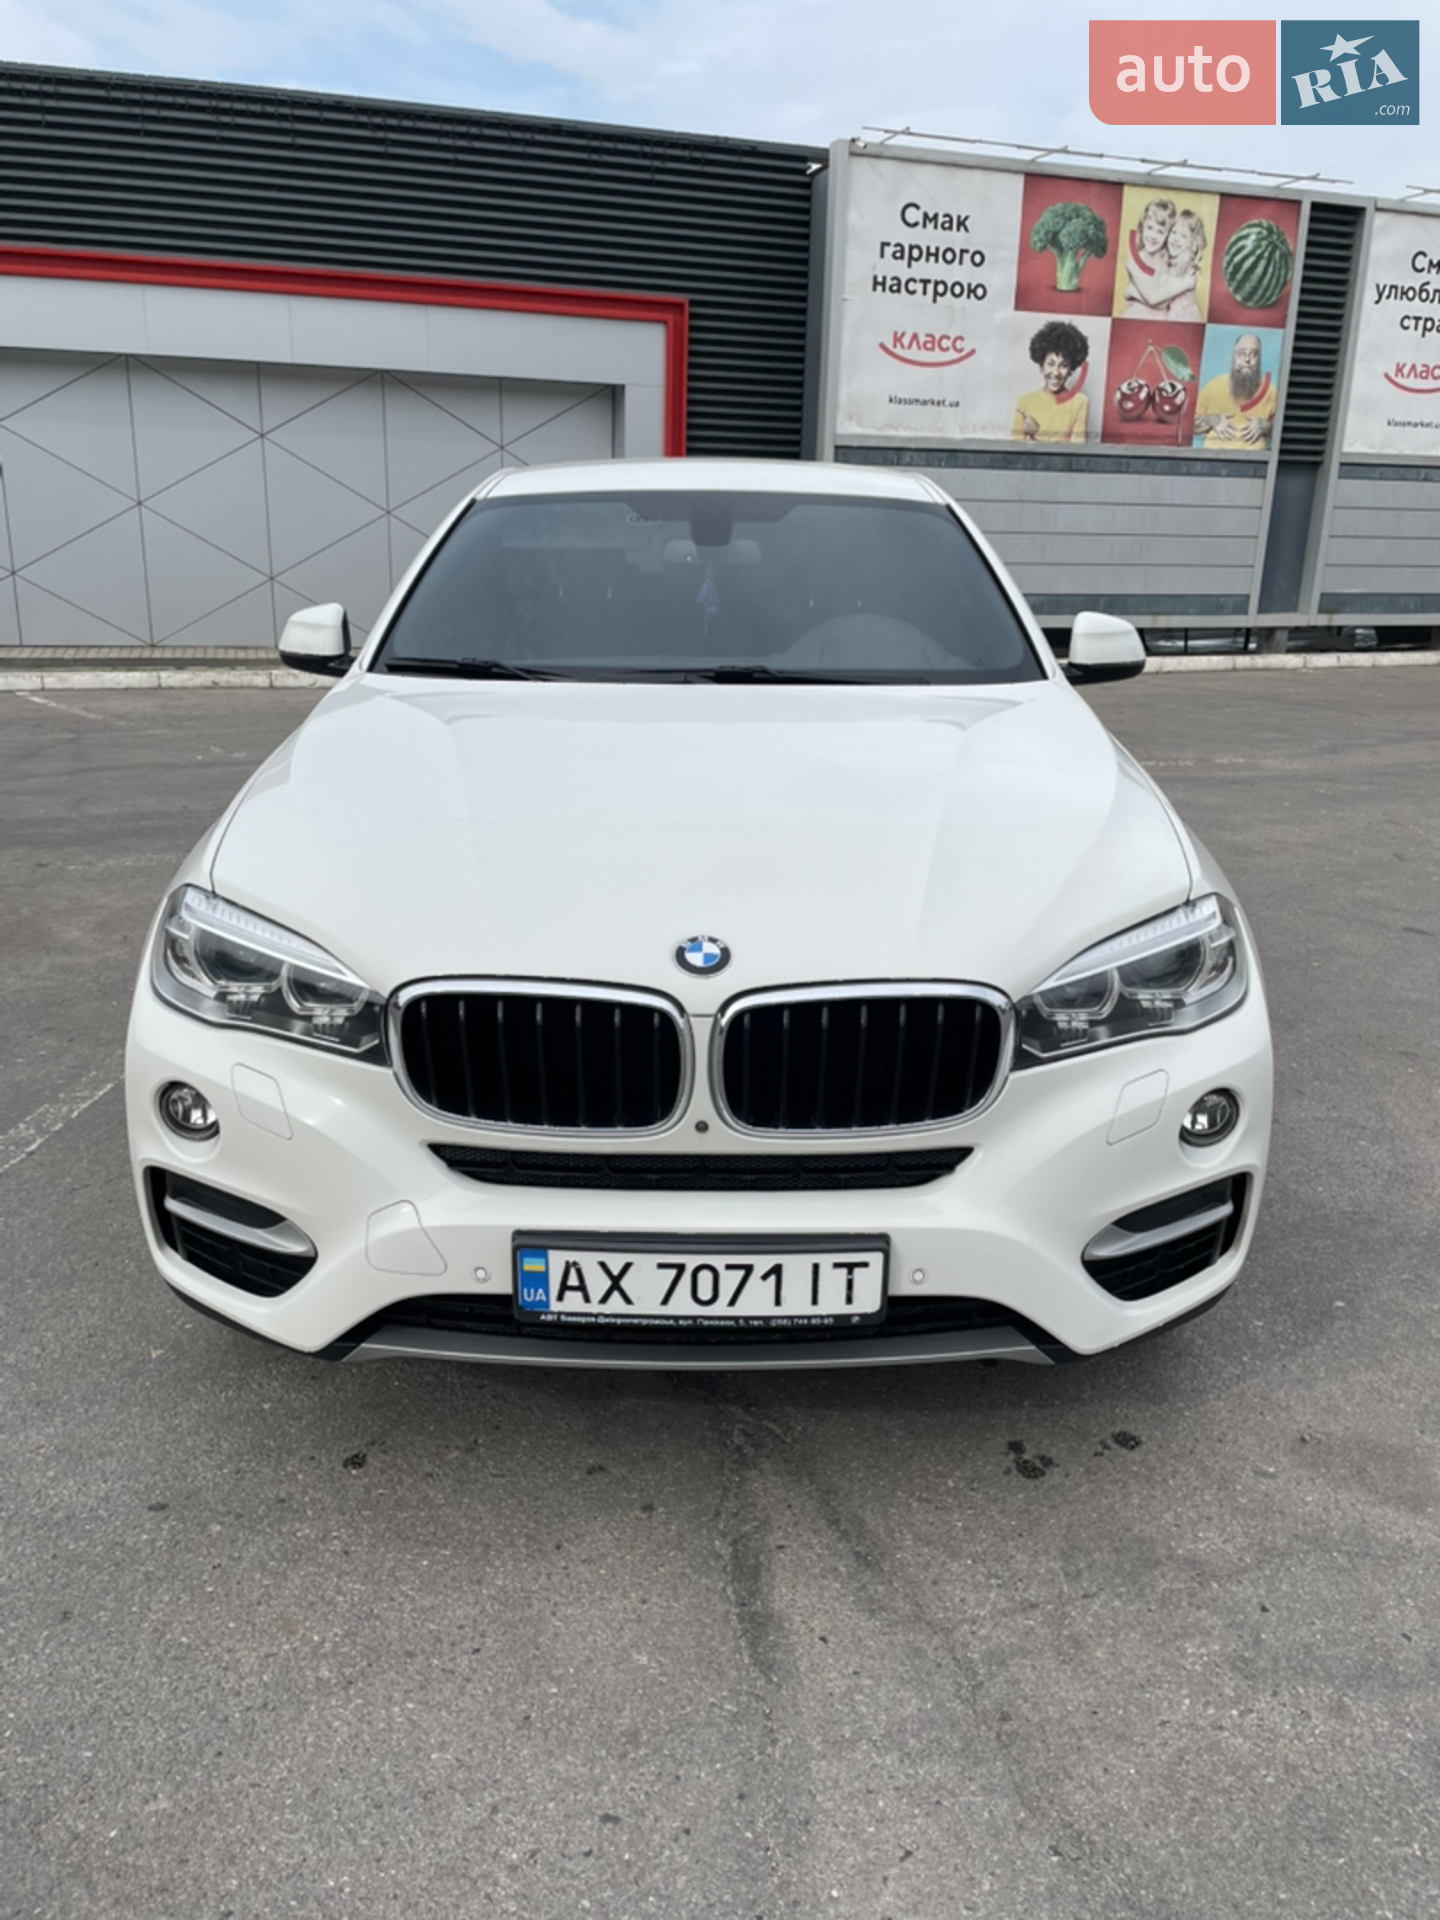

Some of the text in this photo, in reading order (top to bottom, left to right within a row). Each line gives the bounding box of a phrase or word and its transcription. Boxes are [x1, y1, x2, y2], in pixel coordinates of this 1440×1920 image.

[900, 201, 971, 234] Смак
[879, 240, 986, 269] гарного
[871, 274, 988, 304] настрою
[1374, 280, 1440, 305] улюбл
[888, 394, 961, 408] klassmarket.ua
[523, 1288, 547, 1302] UA
[556, 1260, 870, 1307] AX 7071 IT
